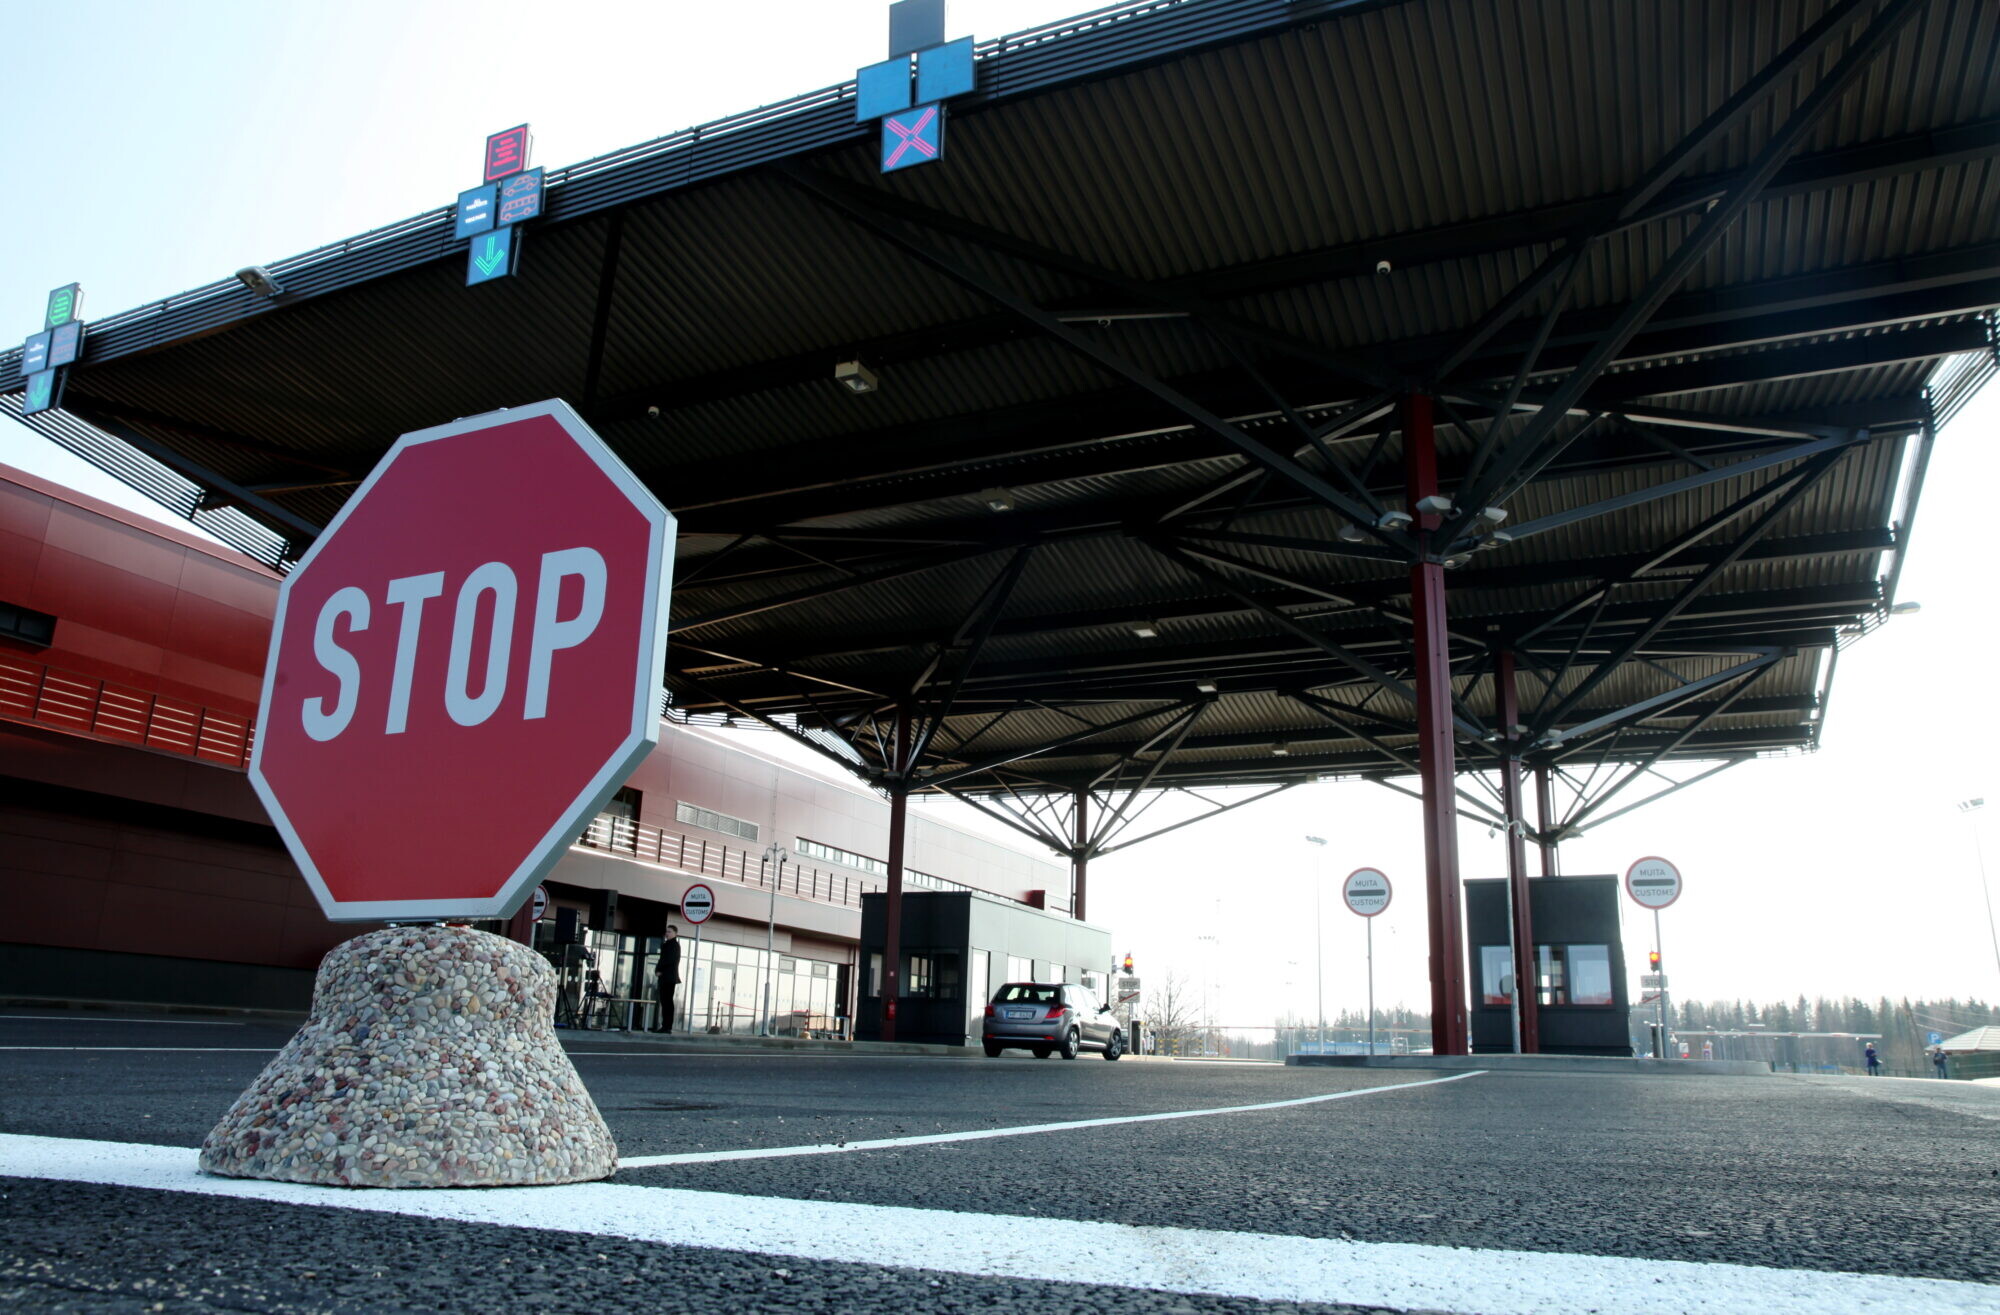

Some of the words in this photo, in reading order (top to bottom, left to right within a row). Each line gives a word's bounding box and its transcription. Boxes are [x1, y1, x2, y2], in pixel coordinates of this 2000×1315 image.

[301, 546, 607, 742] STOP
[1639, 868, 1666, 876] MUITA
[1635, 888, 1674, 897] CUSTOMS
[1350, 898, 1385, 906] CUSTOMS
[1931, 1033, 1939, 1043] P
